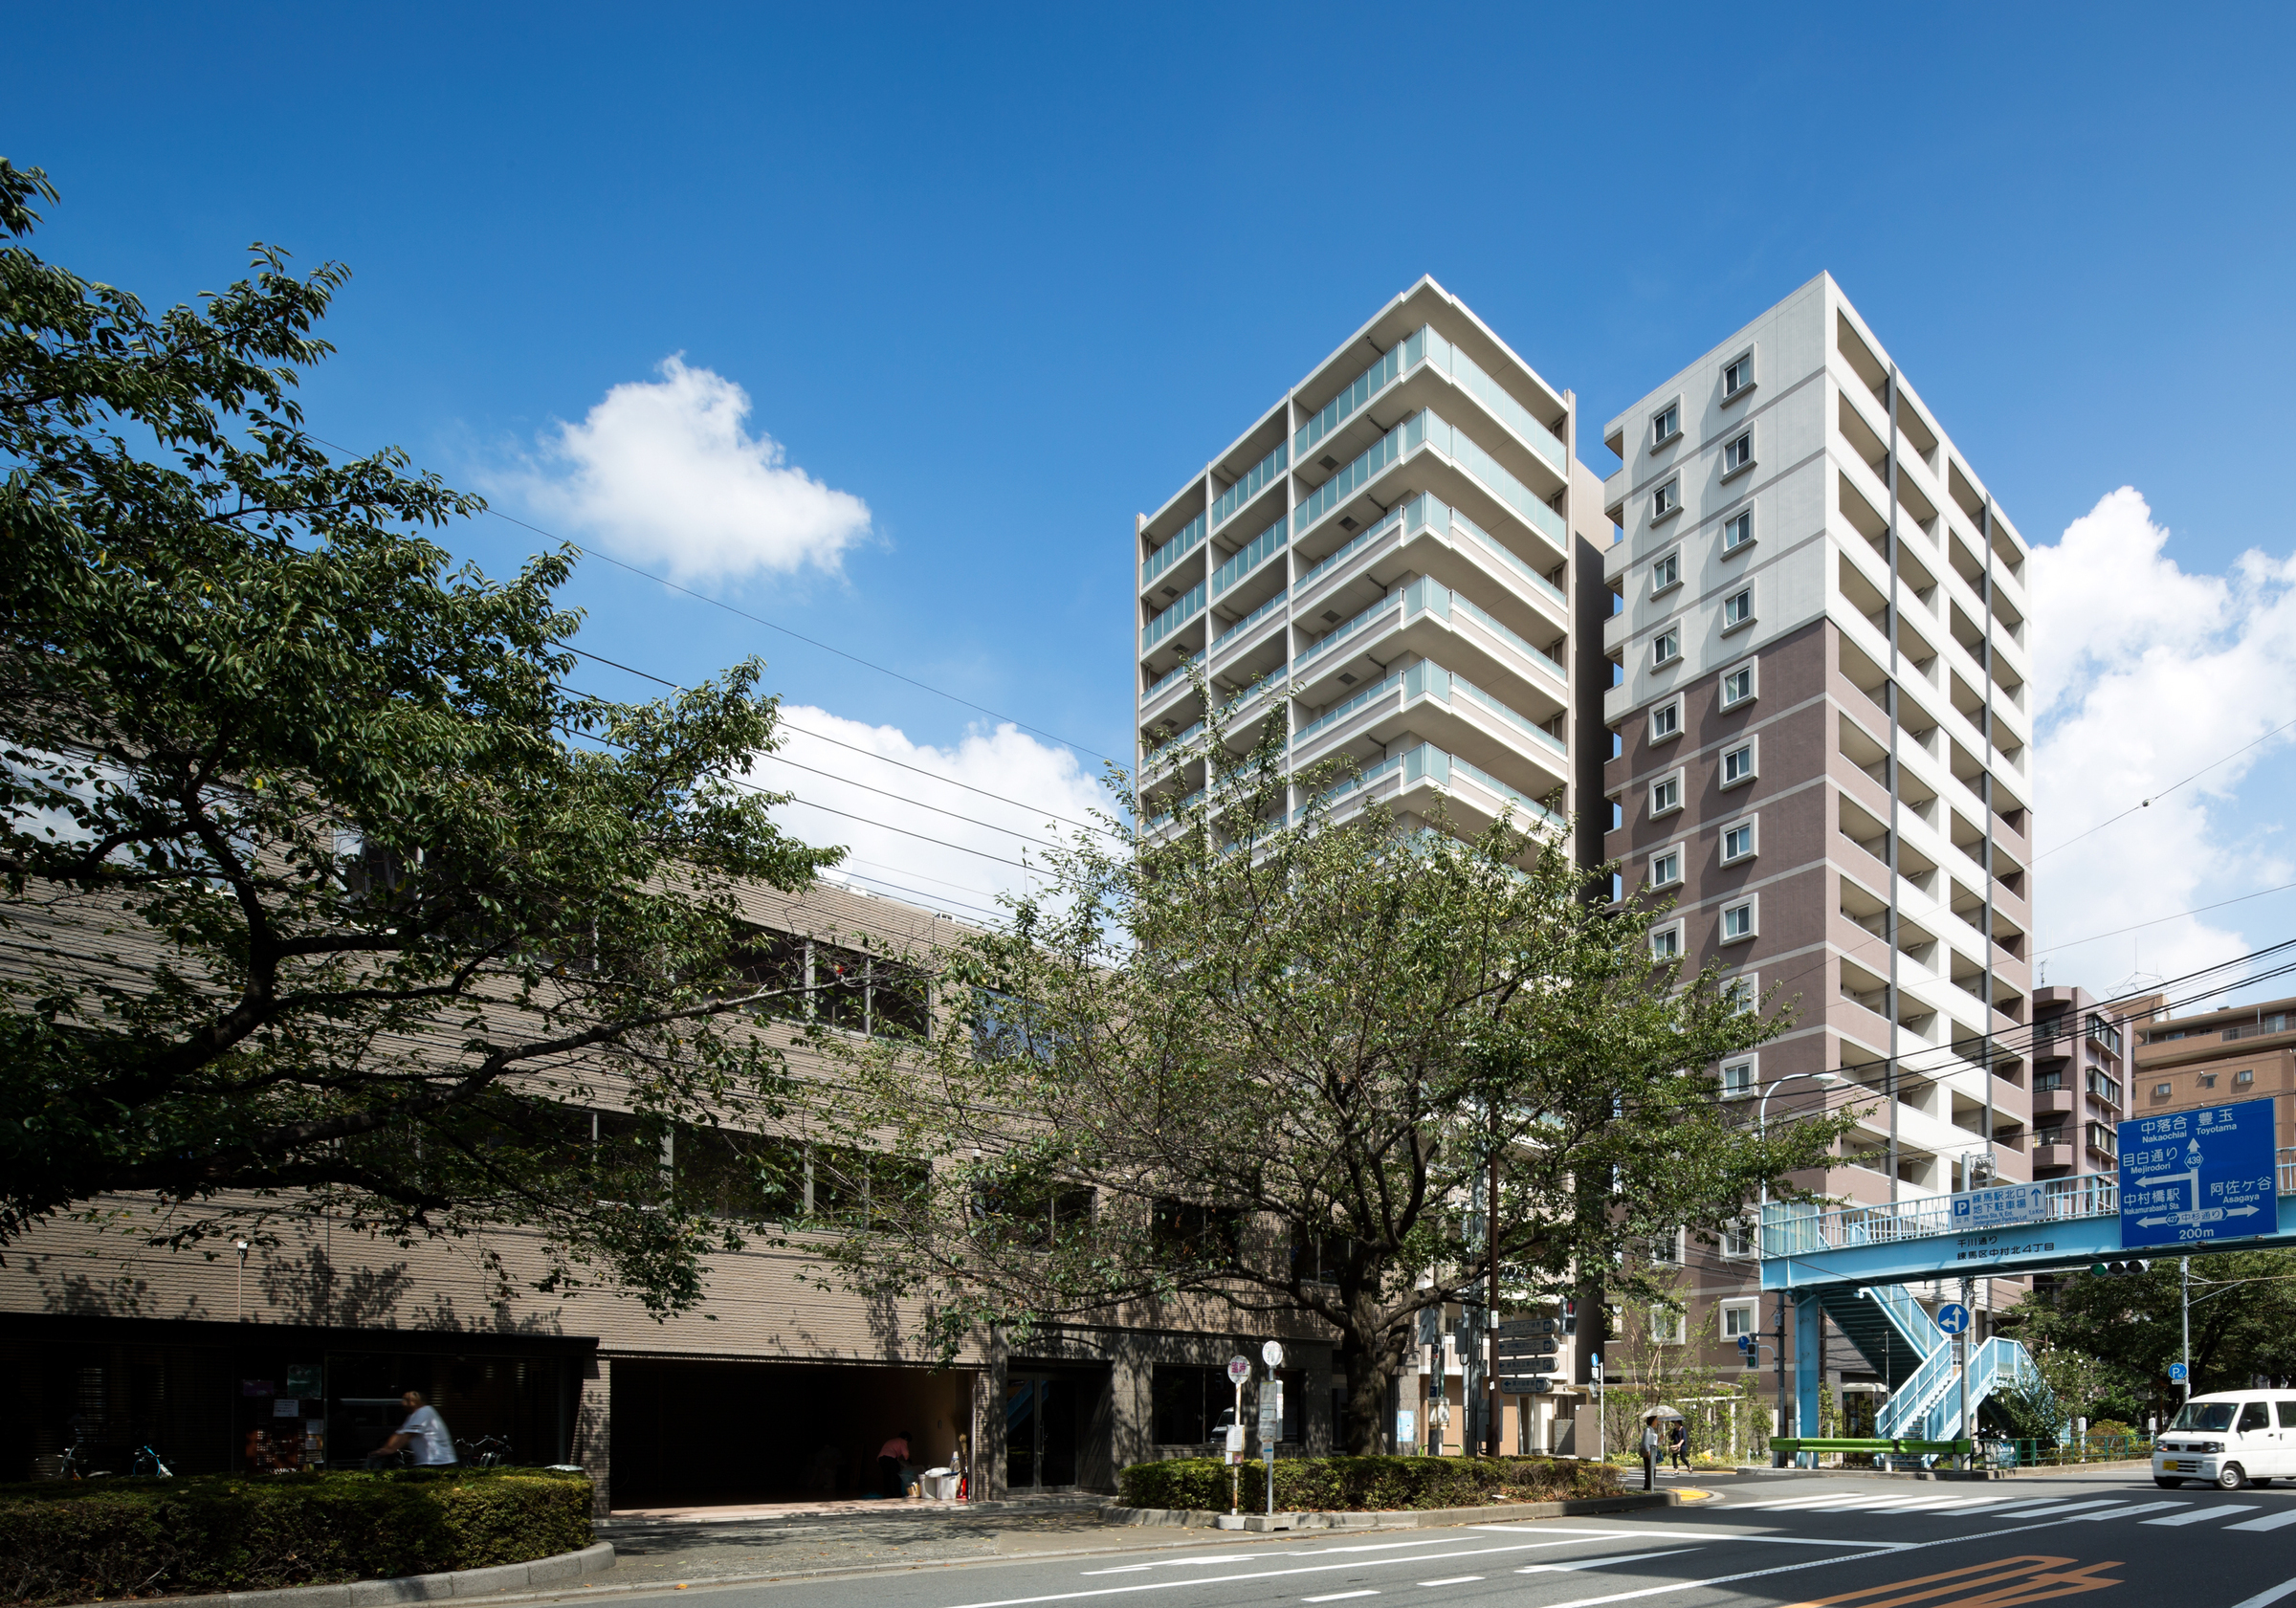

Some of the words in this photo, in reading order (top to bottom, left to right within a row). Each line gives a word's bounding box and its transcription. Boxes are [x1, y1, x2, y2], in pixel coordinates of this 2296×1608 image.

[2141, 1115, 2188, 1135] 中落合
[2197, 1108, 2234, 1127] 豊玉
[2142, 1130, 2187, 1144] Nakaochiai
[2196, 1123, 2238, 1136] Toyotama
[2123, 1147, 2178, 1167] 目白通り
[2186, 1155, 2201, 1166] 439
[2130, 1161, 2171, 1175] Mejirodori
[1973, 1188, 2026, 1204] 練馬駅北口
[2124, 1187, 2181, 1207] 中村橋駅
[2222, 1193, 2260, 1205] Asagaya
[1957, 1201, 1967, 1215] P
[1973, 1199, 2026, 1215] 地下駐車場
[2124, 1203, 2168, 1216] Nakamurabashi
[2169, 1201, 2181, 1211] Sta.
[1973, 1218, 2000, 1226] Underground
[2167, 1215, 2178, 1223] 427
[2181, 1209, 2220, 1223] 中杉通り
[2178, 1228, 2215, 1240] 200m
[1957, 1235, 1998, 1248] 千川通り
[2173, 1368, 2180, 1377] P
